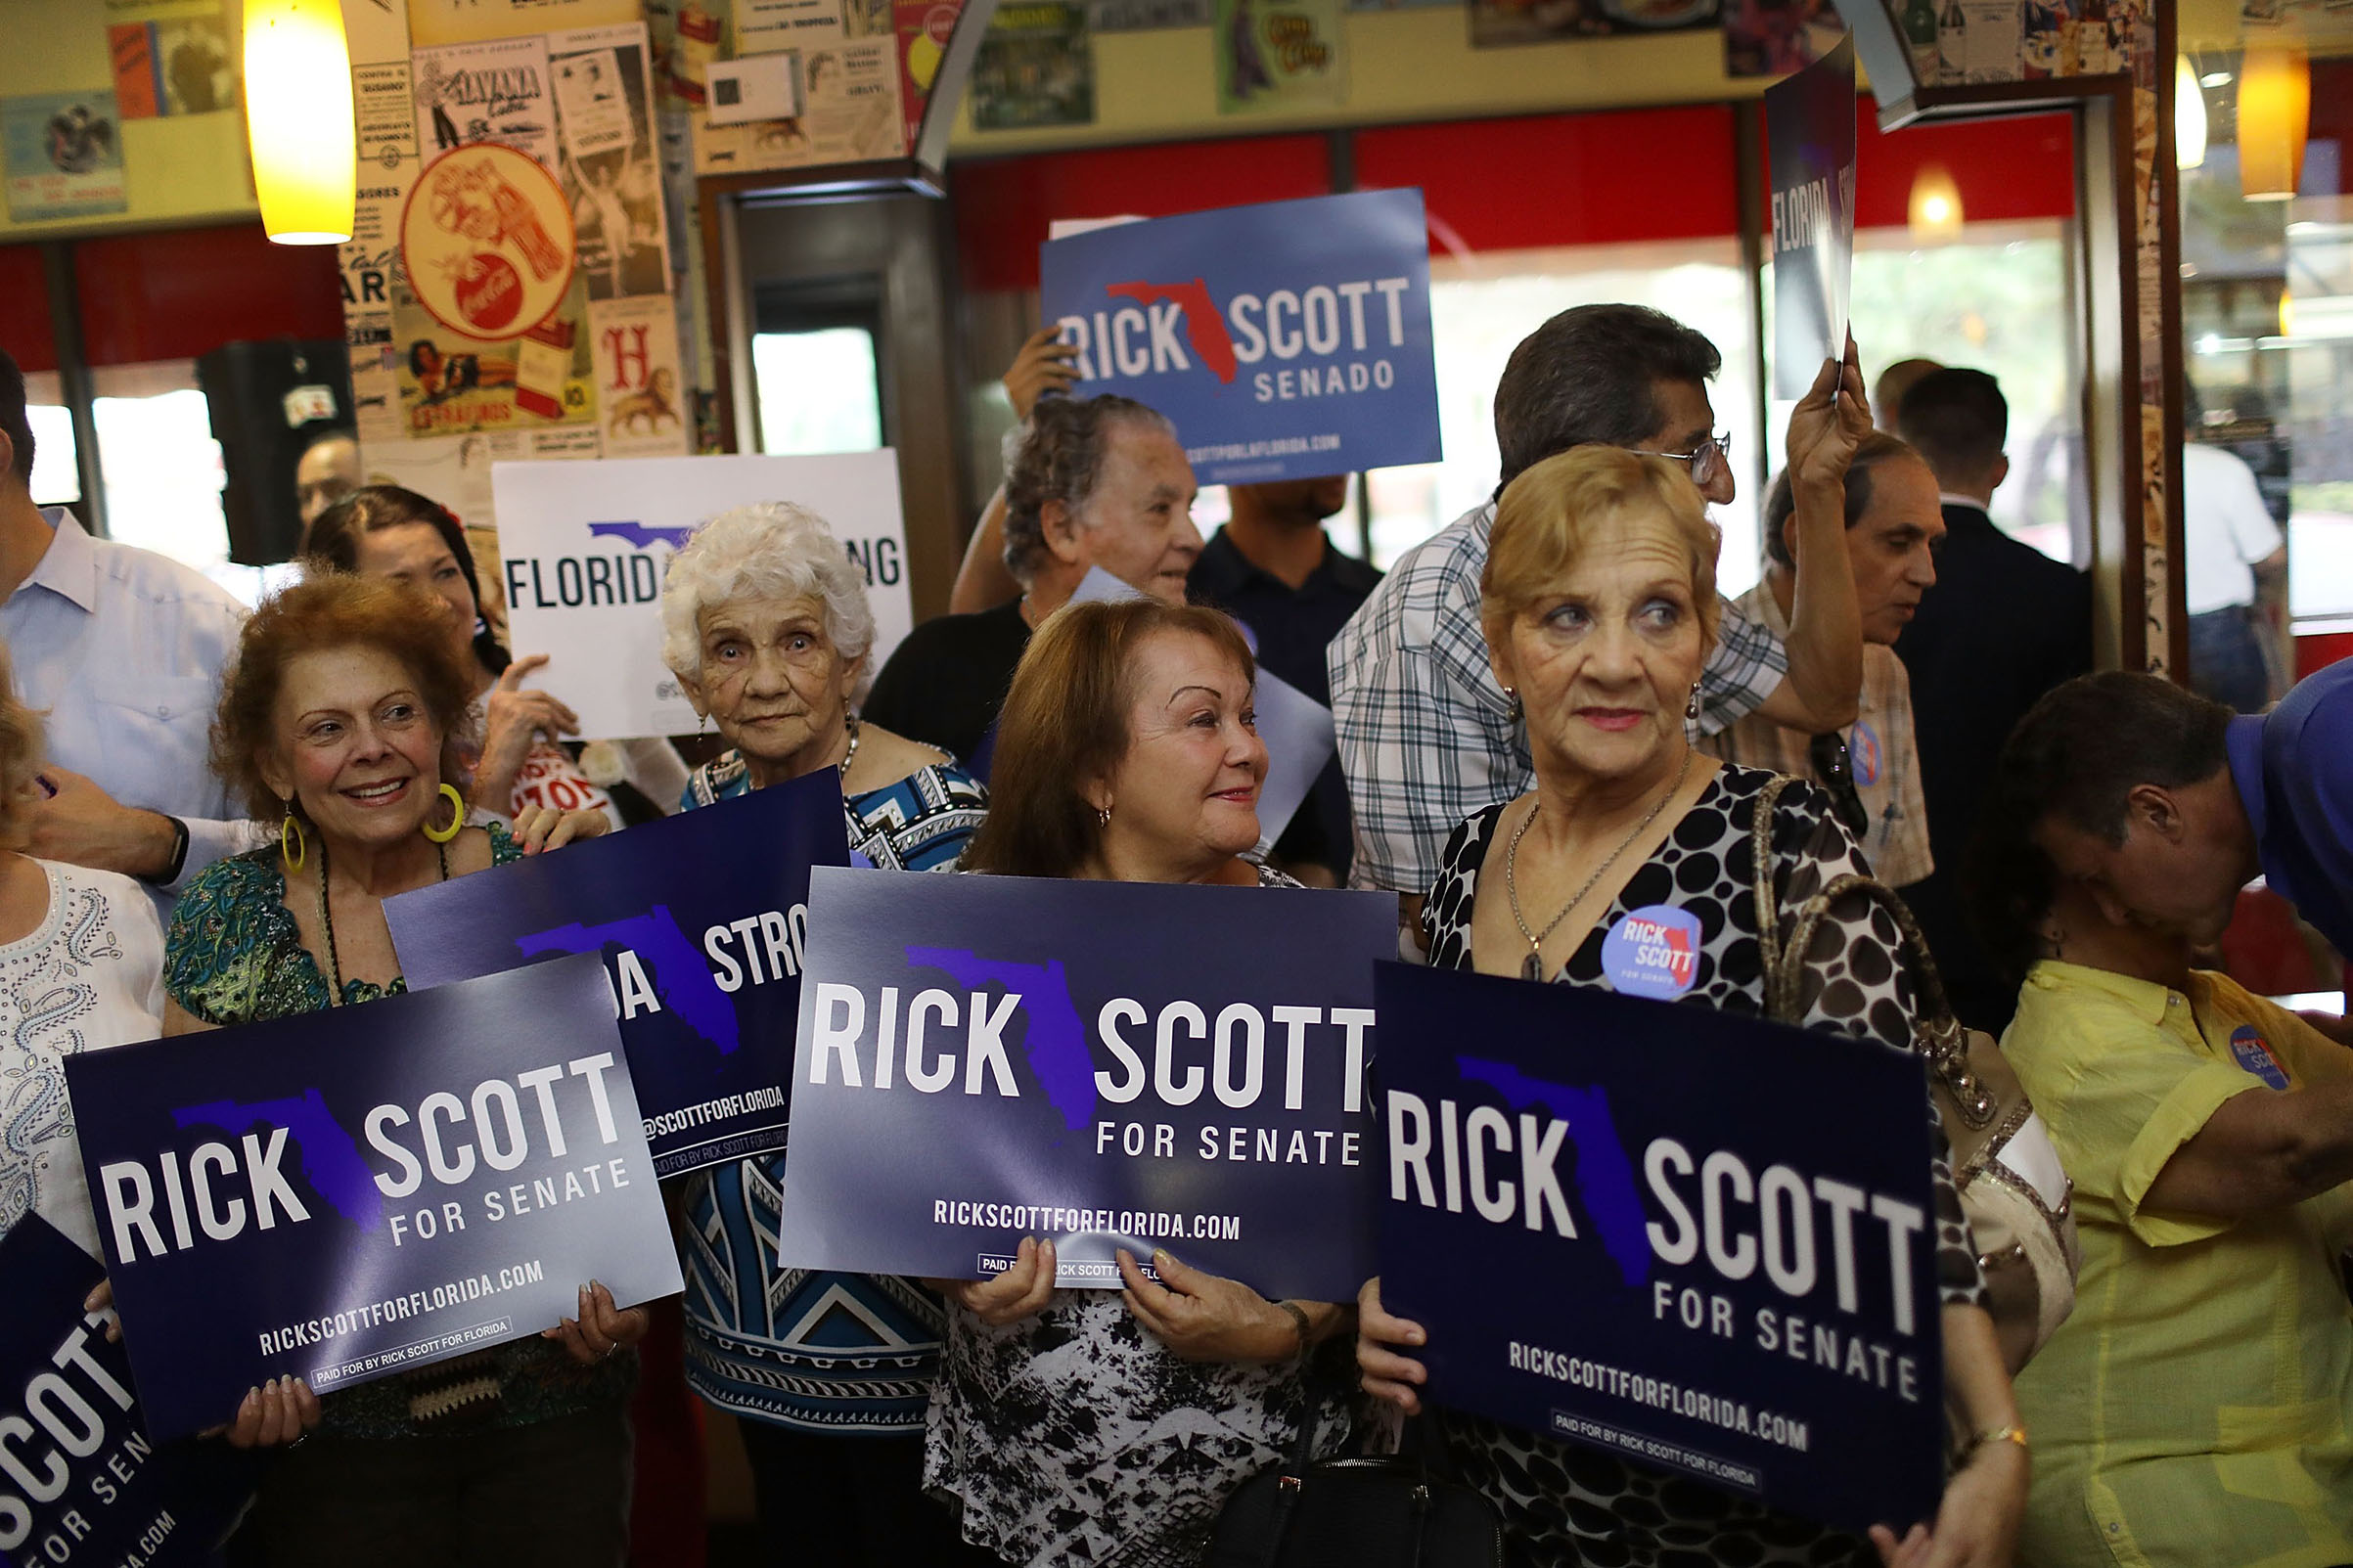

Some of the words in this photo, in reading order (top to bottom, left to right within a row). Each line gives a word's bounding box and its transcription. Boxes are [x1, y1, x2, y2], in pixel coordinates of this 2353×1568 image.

[1057, 303, 1191, 381] RICK
[1229, 278, 1409, 363] SCOTT
[1254, 360, 1394, 402] SENADO
[505, 551, 669, 609] FLORID
[1623, 919, 1667, 945] RICK
[1635, 945, 1694, 972] SCOTT
[809, 982, 1022, 1098] RICK
[1094, 997, 1376, 1112] SCOTT
[642, 1086, 785, 1141] @SCOTTFORFLORIDA
[1097, 1122, 1174, 1158] FOR
[1199, 1126, 1361, 1166] SENATE
[100, 1126, 311, 1264] RICK
[364, 1052, 620, 1198] SCOTT
[670, 1154, 688, 1170] FOR
[689, 1149, 701, 1164] BY
[701, 1144, 724, 1160] RICK
[723, 1137, 749, 1155] SCOTT
[388, 1200, 467, 1247] FOR
[485, 1157, 631, 1222] SENATE
[934, 1199, 1241, 1241] RICKSCOTTFORFLORIDA.COM
[1387, 1089, 1578, 1240] RICK
[1644, 1138, 1923, 1337] SCOTT
[982, 1258, 1008, 1271] PAID
[1056, 1264, 1076, 1276] ICK
[1078, 1265, 1114, 1277] SCOTT
[259, 1260, 545, 1357] RICKSCOTTFORFLORIDA.COM
[316, 1367, 340, 1384] PAID
[342, 1362, 365, 1376] FOR
[365, 1357, 381, 1369] BY
[381, 1348, 407, 1366] RICK
[407, 1340, 440, 1358] SCOTT
[441, 1334, 464, 1349] FOR
[464, 1321, 508, 1342] FLORIDA
[1653, 1280, 1735, 1339] FOR
[1756, 1308, 1920, 1404] SENATE
[1509, 1341, 1808, 1453] RICKSCOTTFORFLORIDA.COM
[1556, 1414, 1579, 1432] PAID
[1580, 1421, 1603, 1439] FOR
[1603, 1428, 1618, 1443] BY
[1619, 1433, 1645, 1452] RICK
[1647, 1442, 1682, 1462] SCOTT
[1683, 1453, 1706, 1471] FOR
[1707, 1459, 1756, 1486] FLORIDA
